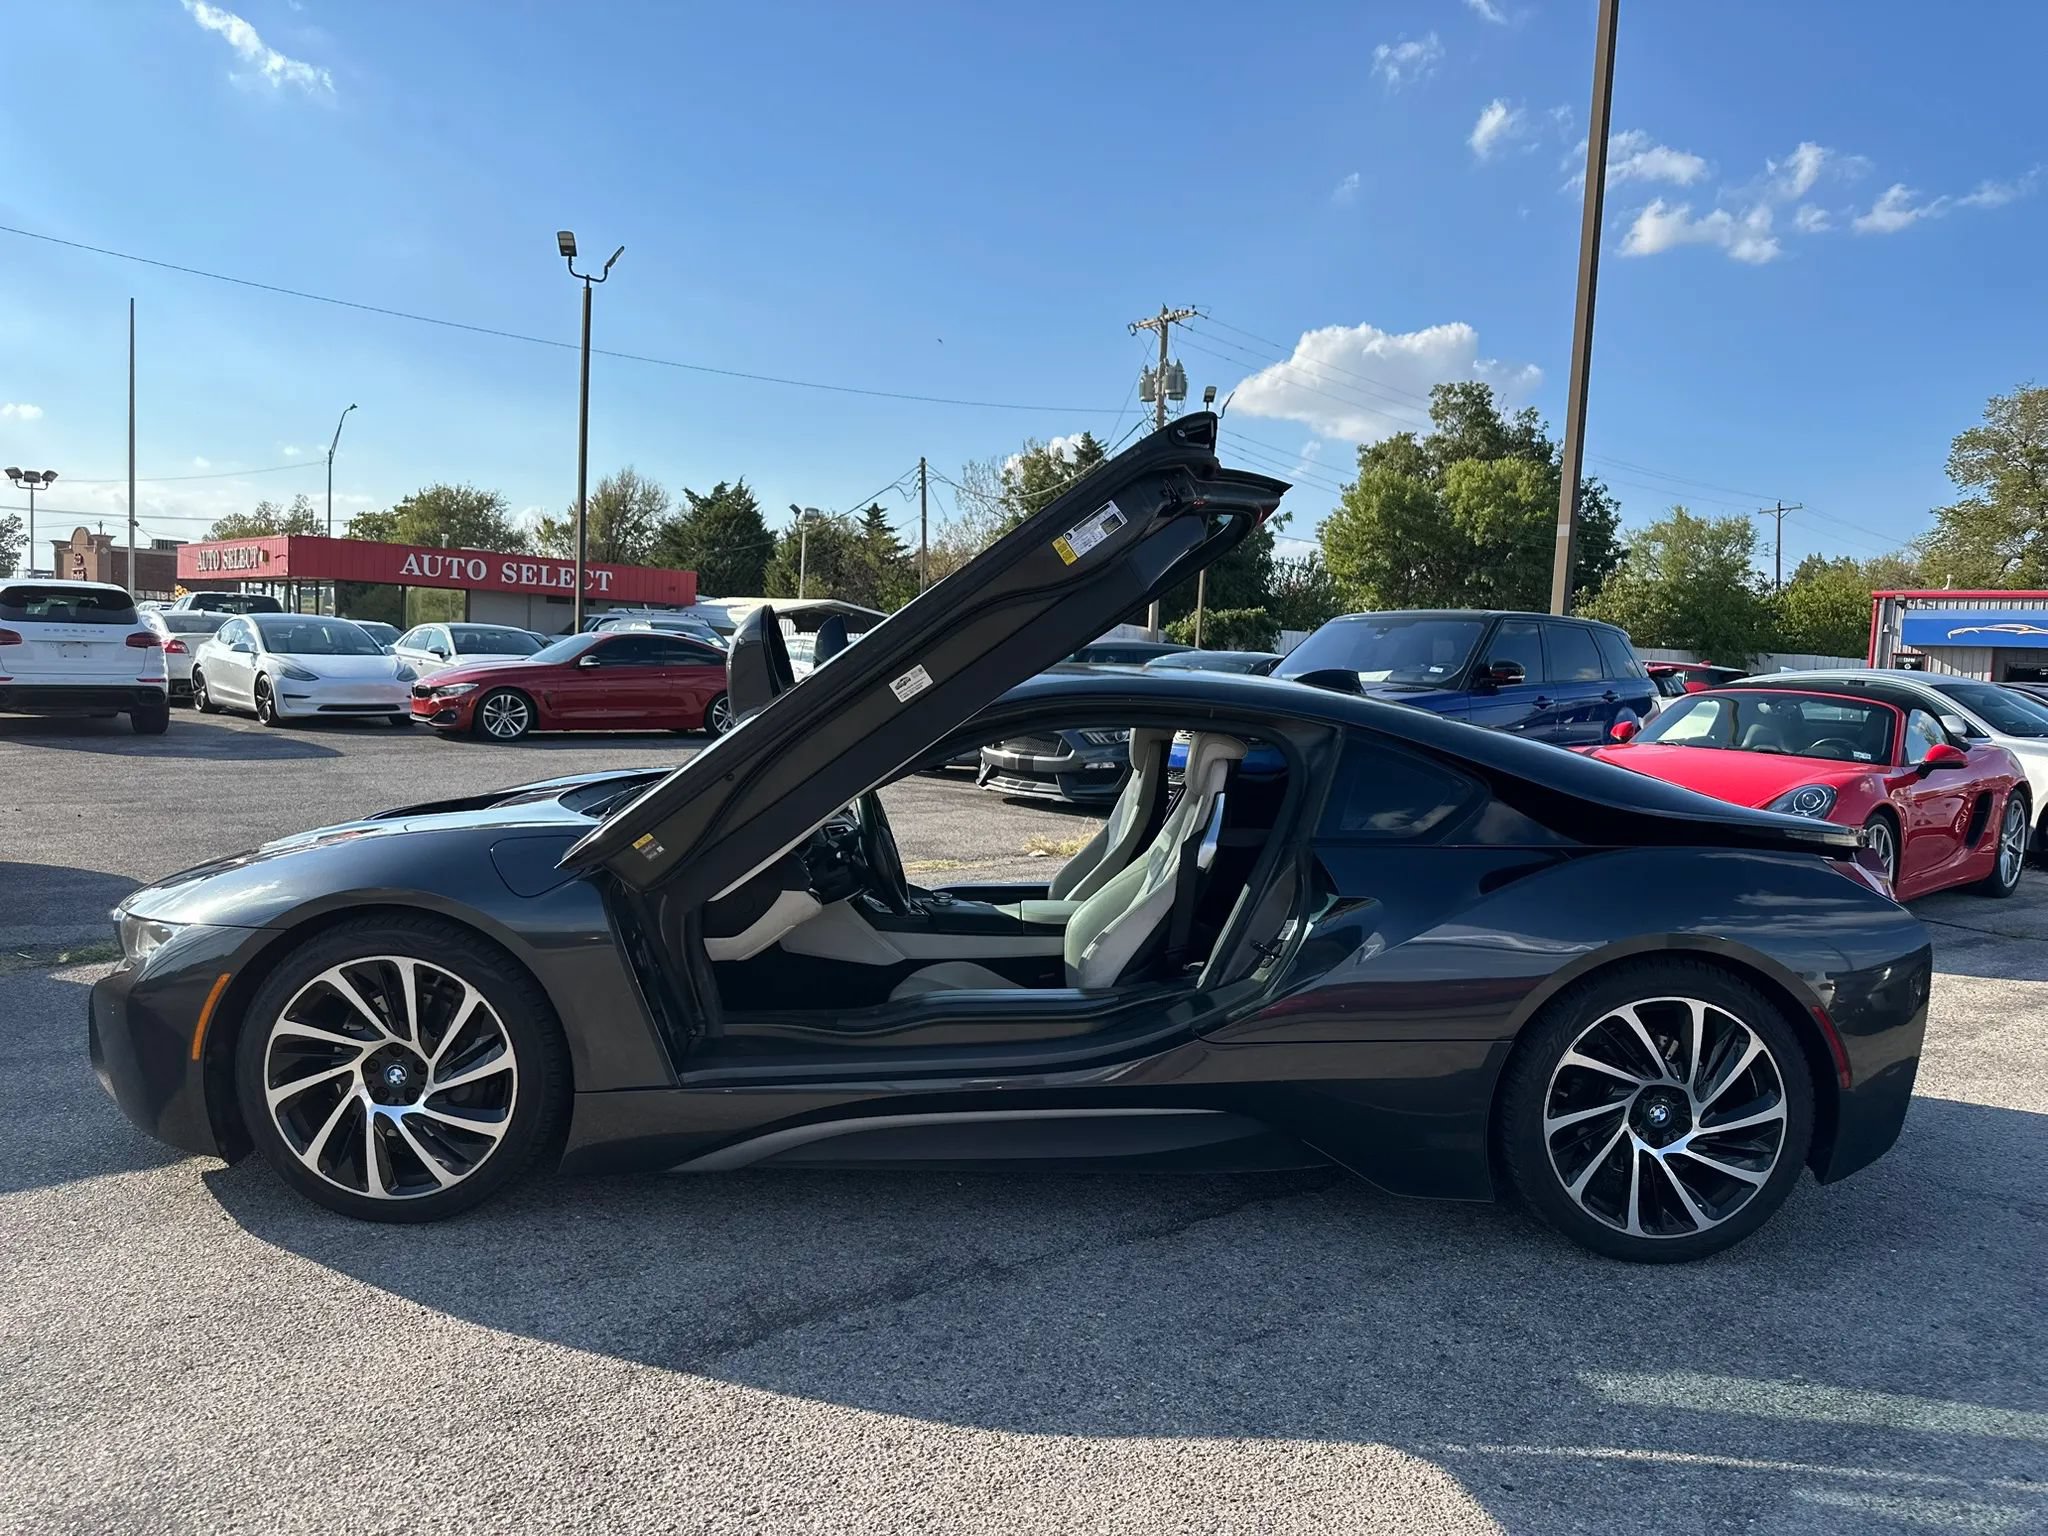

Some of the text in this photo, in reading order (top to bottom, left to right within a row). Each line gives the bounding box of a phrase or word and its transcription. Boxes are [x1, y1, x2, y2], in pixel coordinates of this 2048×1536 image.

[197, 545, 259, 571] AUTO SELECT
[400, 553, 487, 581] AUTO
